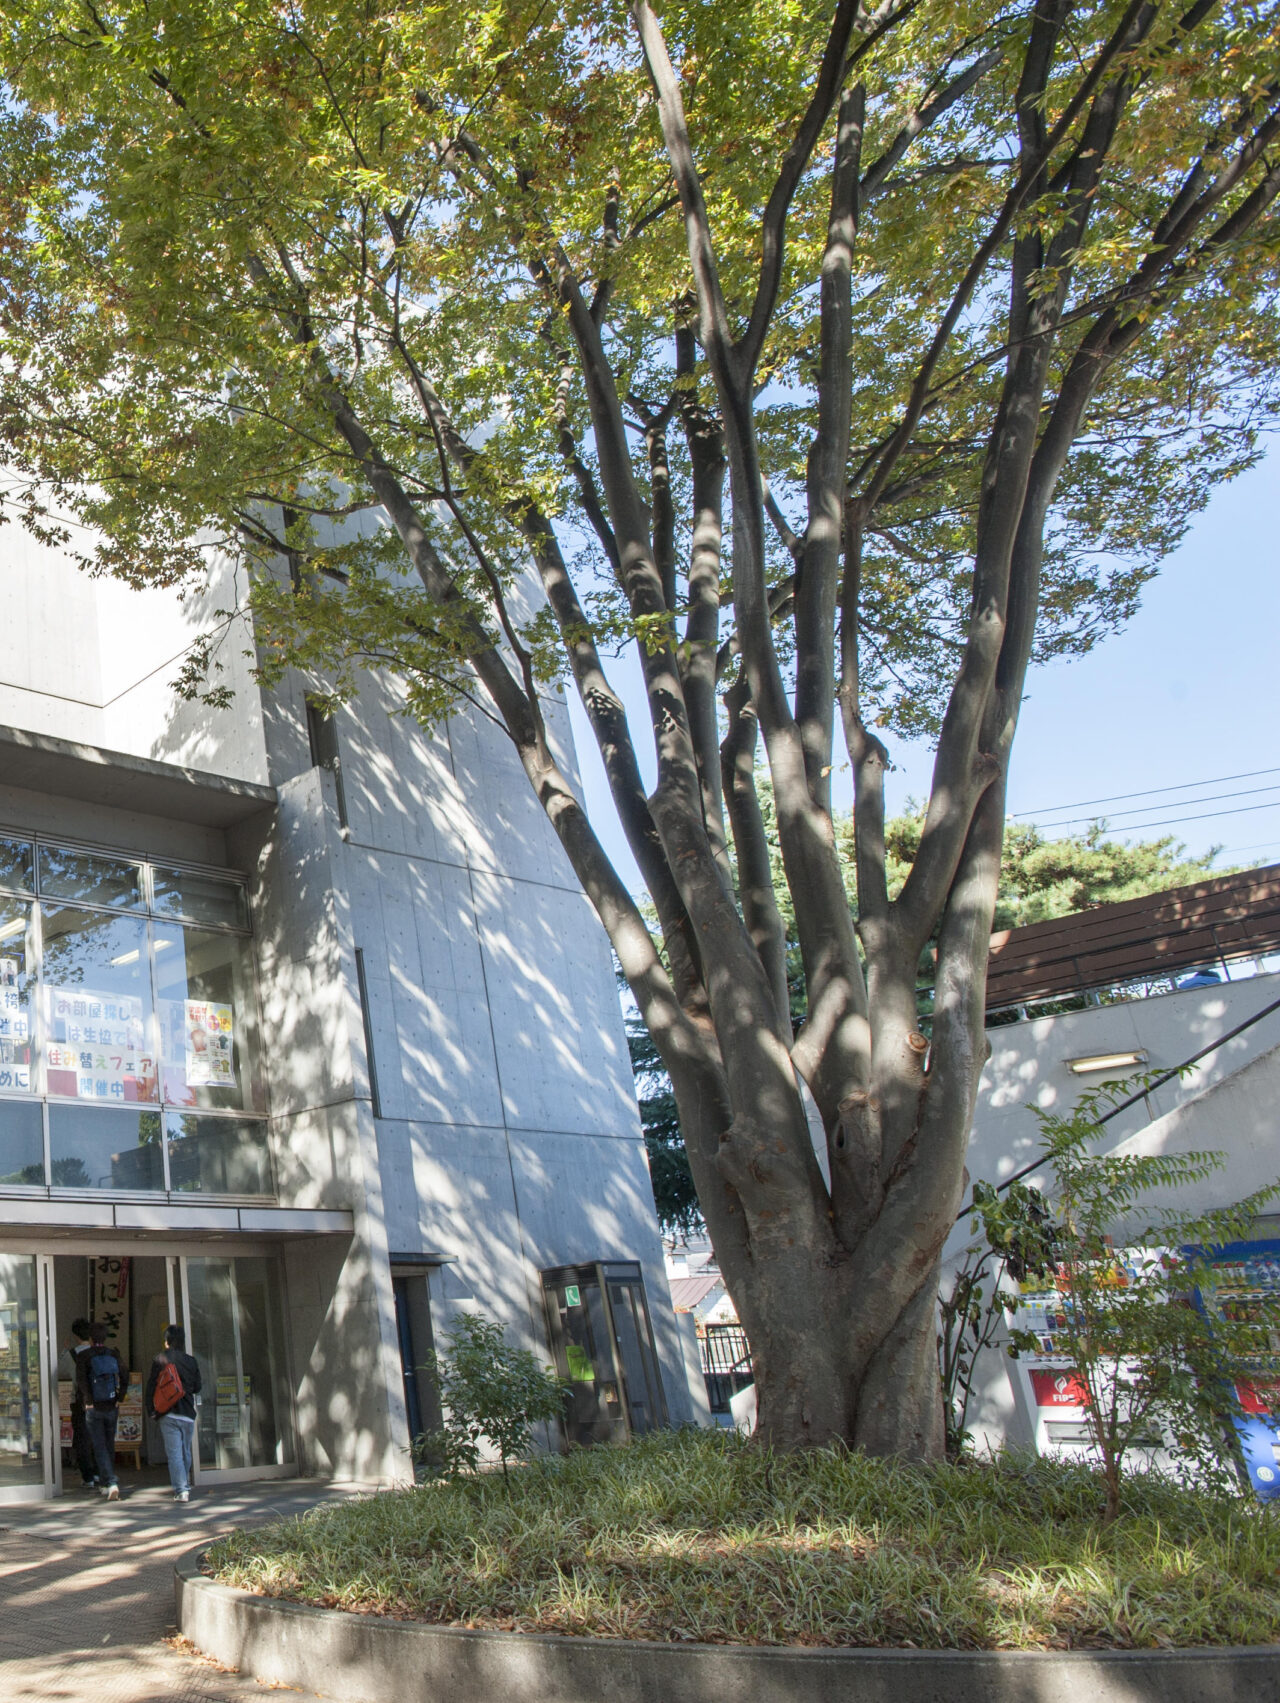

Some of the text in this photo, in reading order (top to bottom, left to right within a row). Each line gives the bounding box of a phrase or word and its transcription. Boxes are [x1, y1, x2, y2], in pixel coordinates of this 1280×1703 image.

[57, 999, 131, 1021] お部屋探し
[48, 1049, 152, 1073] 住み替えフェア
[79, 1078, 124, 1098] 開催中
